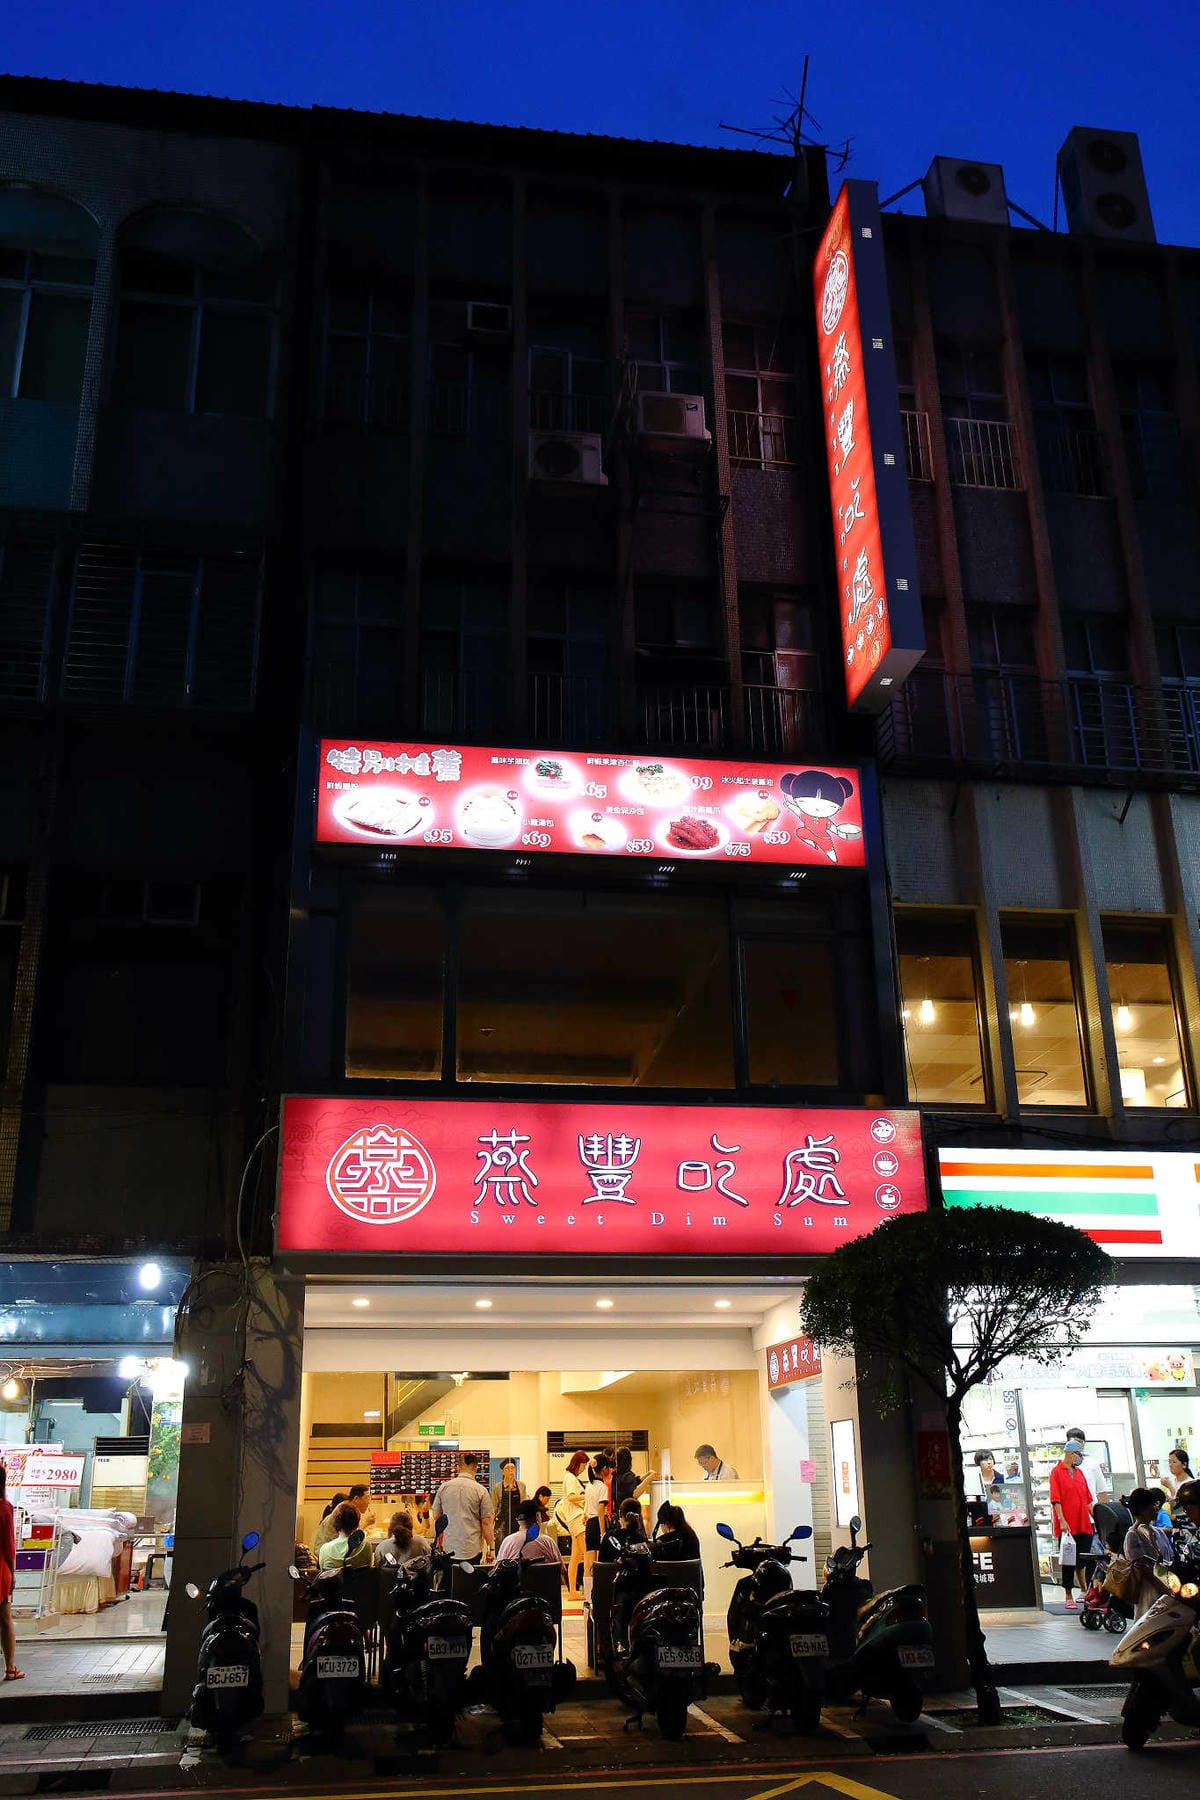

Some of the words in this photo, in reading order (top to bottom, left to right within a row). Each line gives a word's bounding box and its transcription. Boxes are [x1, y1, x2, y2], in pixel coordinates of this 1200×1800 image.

[326, 746, 462, 782] 特別推薦
[423, 829, 454, 843] $95
[521, 831, 552, 847] $69
[763, 831, 791, 845] $59
[626, 838, 655, 853] $59
[724, 841, 752, 857] $75
[473, 1127, 851, 1208] 蒸豐吃處
[469, 1210, 605, 1225] Sweet
[650, 1211, 727, 1226] Dim
[773, 1212, 849, 1227] Sum
[208, 1672, 248, 1685] BCJ-657
